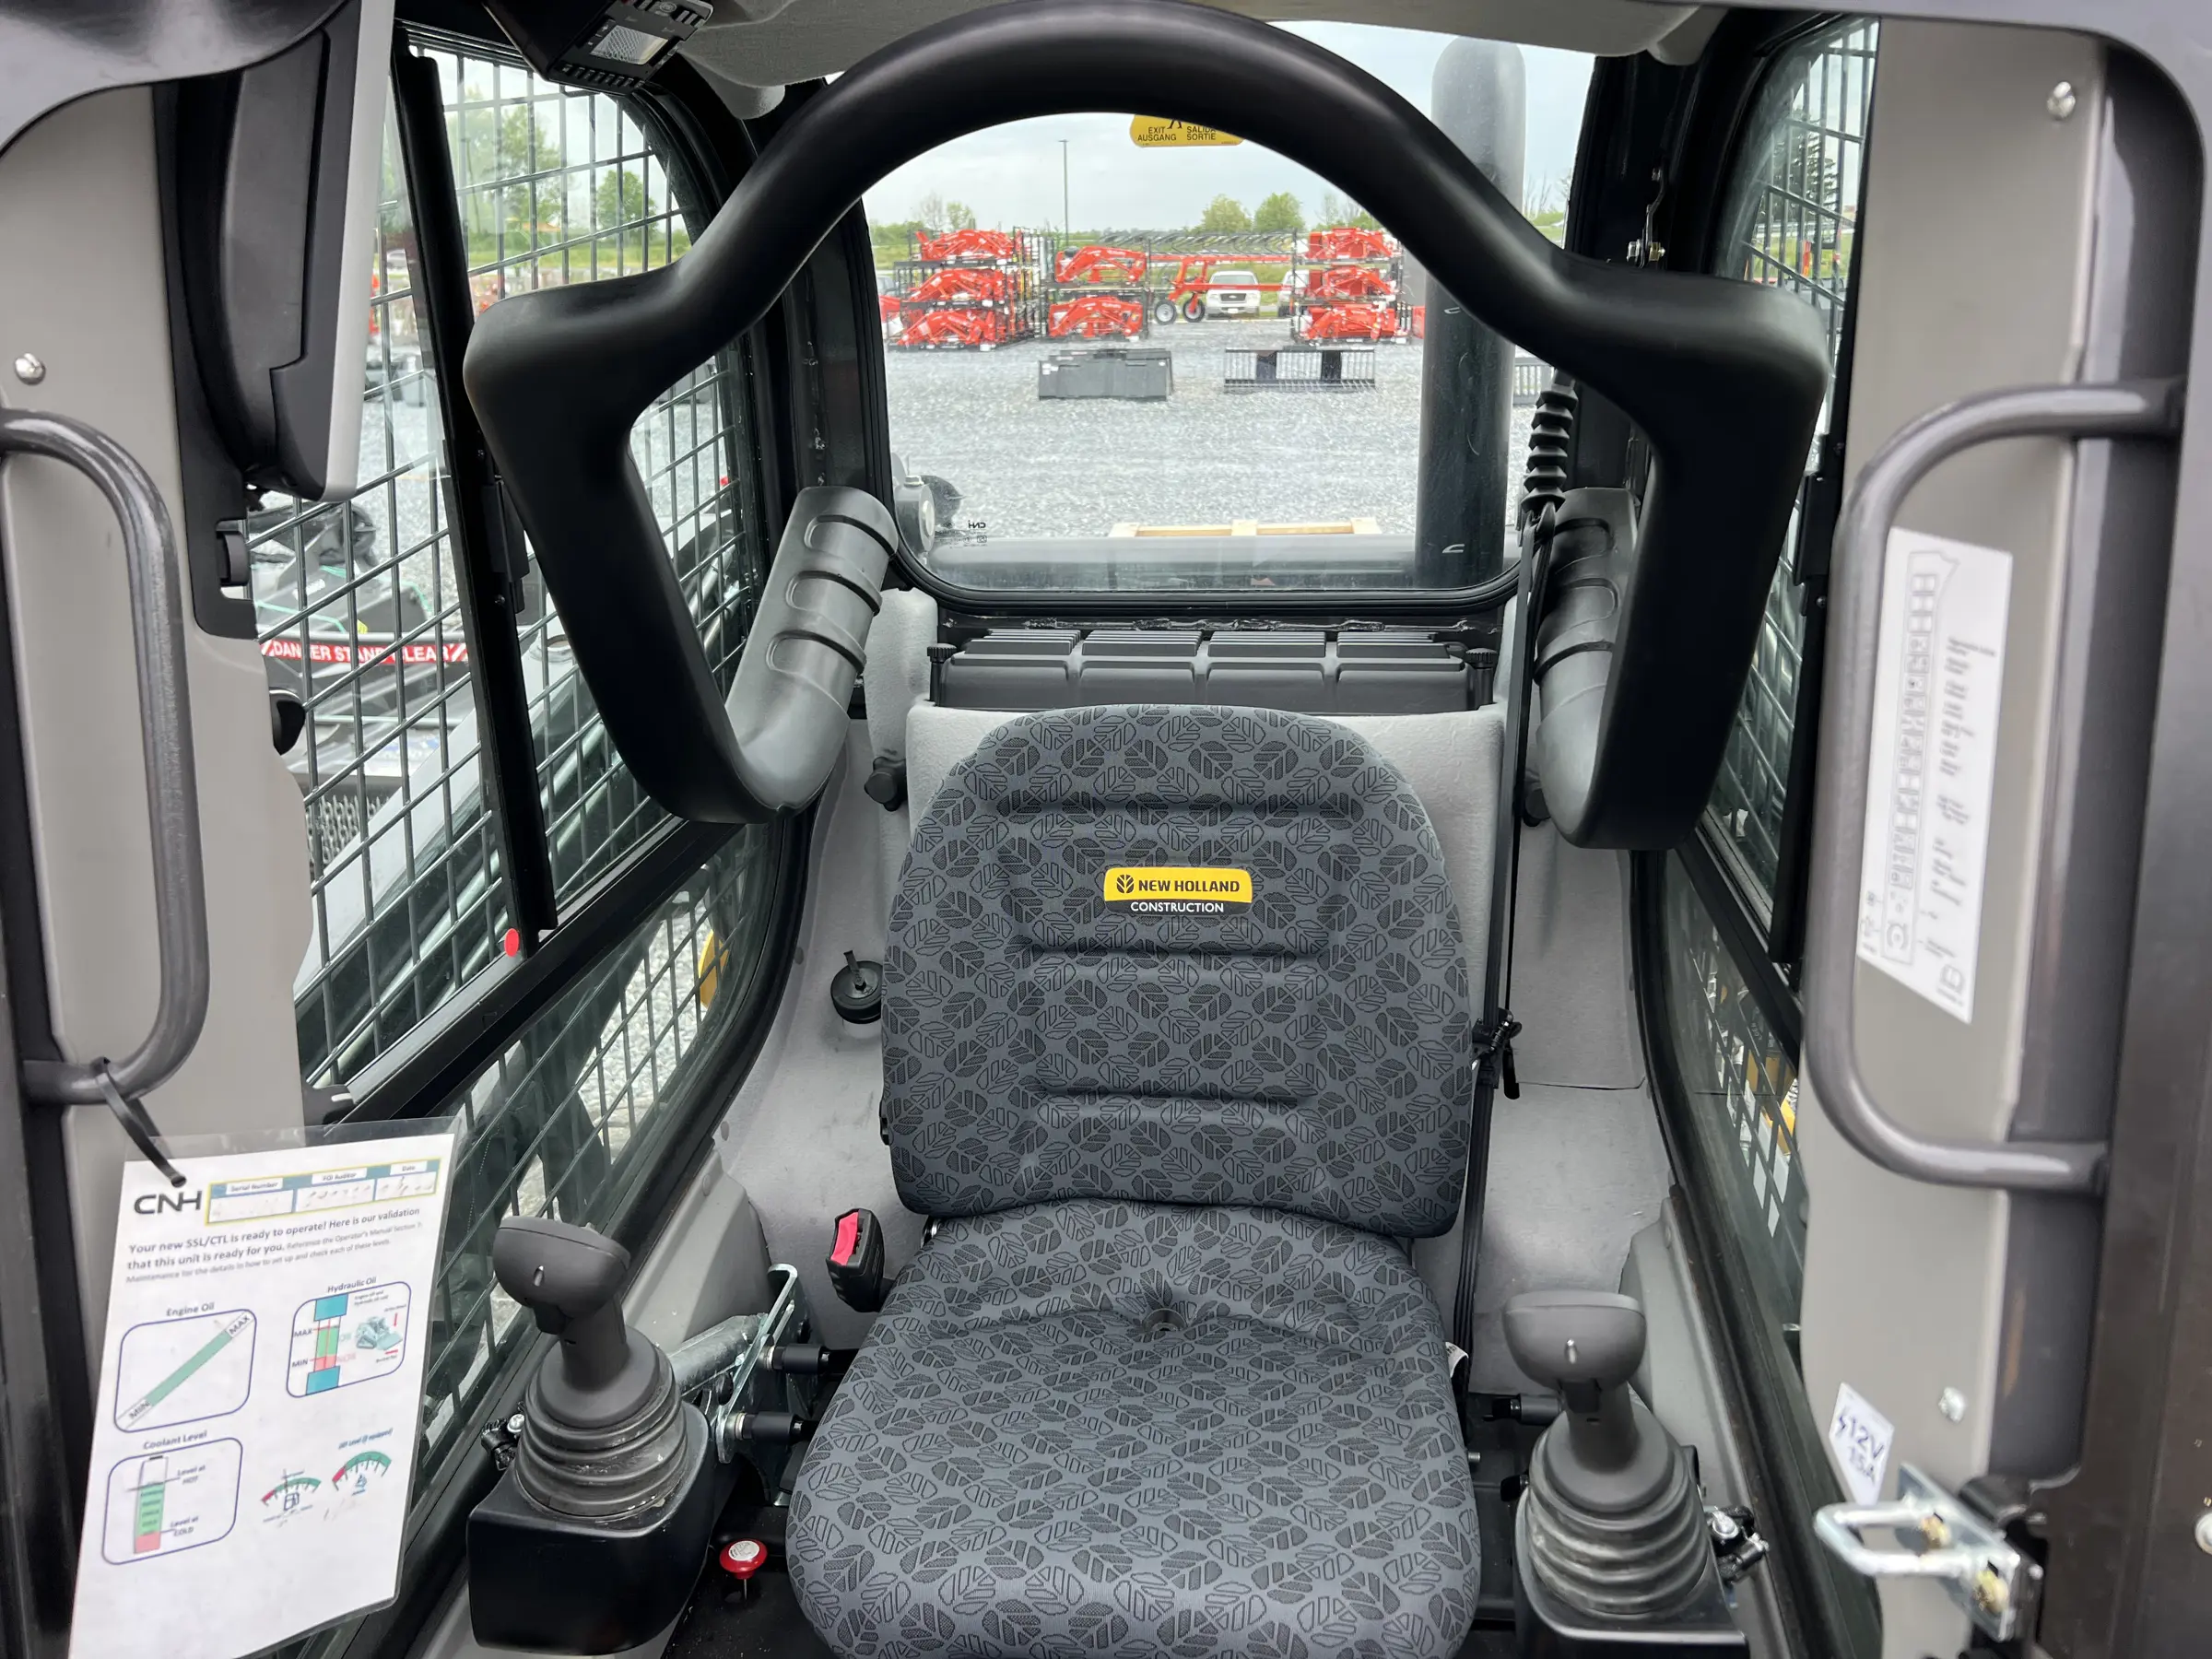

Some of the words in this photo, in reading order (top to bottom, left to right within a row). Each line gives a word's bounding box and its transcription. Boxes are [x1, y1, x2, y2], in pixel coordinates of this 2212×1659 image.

[273, 641, 332, 662] DANER
[1138, 879, 1171, 892] NEW
[1174, 879, 1241, 892] HOLLAND
[1130, 901, 1224, 913] CONSTRUCTION
[134, 1190, 203, 1215] CNH
[128, 1242, 156, 1254] Your
[159, 1241, 183, 1252] new
[186, 1235, 228, 1249] SSL/CTL
[230, 1233, 239, 1242] is
[241, 1229, 271, 1241] ready
[273, 1229, 284, 1237] to
[286, 1221, 327, 1237] operate!
[329, 1218, 350, 1230] Here
[352, 1216, 359, 1225] is
[361, 1214, 376, 1224] our
[378, 1207, 420, 1221] validation
[127, 1258, 151, 1270] that
[155, 1255, 175, 1267] this
[178, 1253, 200, 1265] unit
[203, 1252, 211, 1262] is
[214, 1247, 244, 1261] ready
[246, 1245, 261, 1255] for
[327, 1279, 365, 1293] Hydraulic
[366, 1277, 377, 1285] Oil
[166, 1305, 199, 1317] Engine
[200, 1301, 215, 1312] Oil
[229, 1315, 251, 1335] MAX
[294, 1327, 313, 1338] MAX
[291, 1359, 309, 1368] MIN
[128, 1401, 151, 1420] MIN
[143, 1436, 182, 1450] Coolant
[182, 1430, 207, 1442] Level
